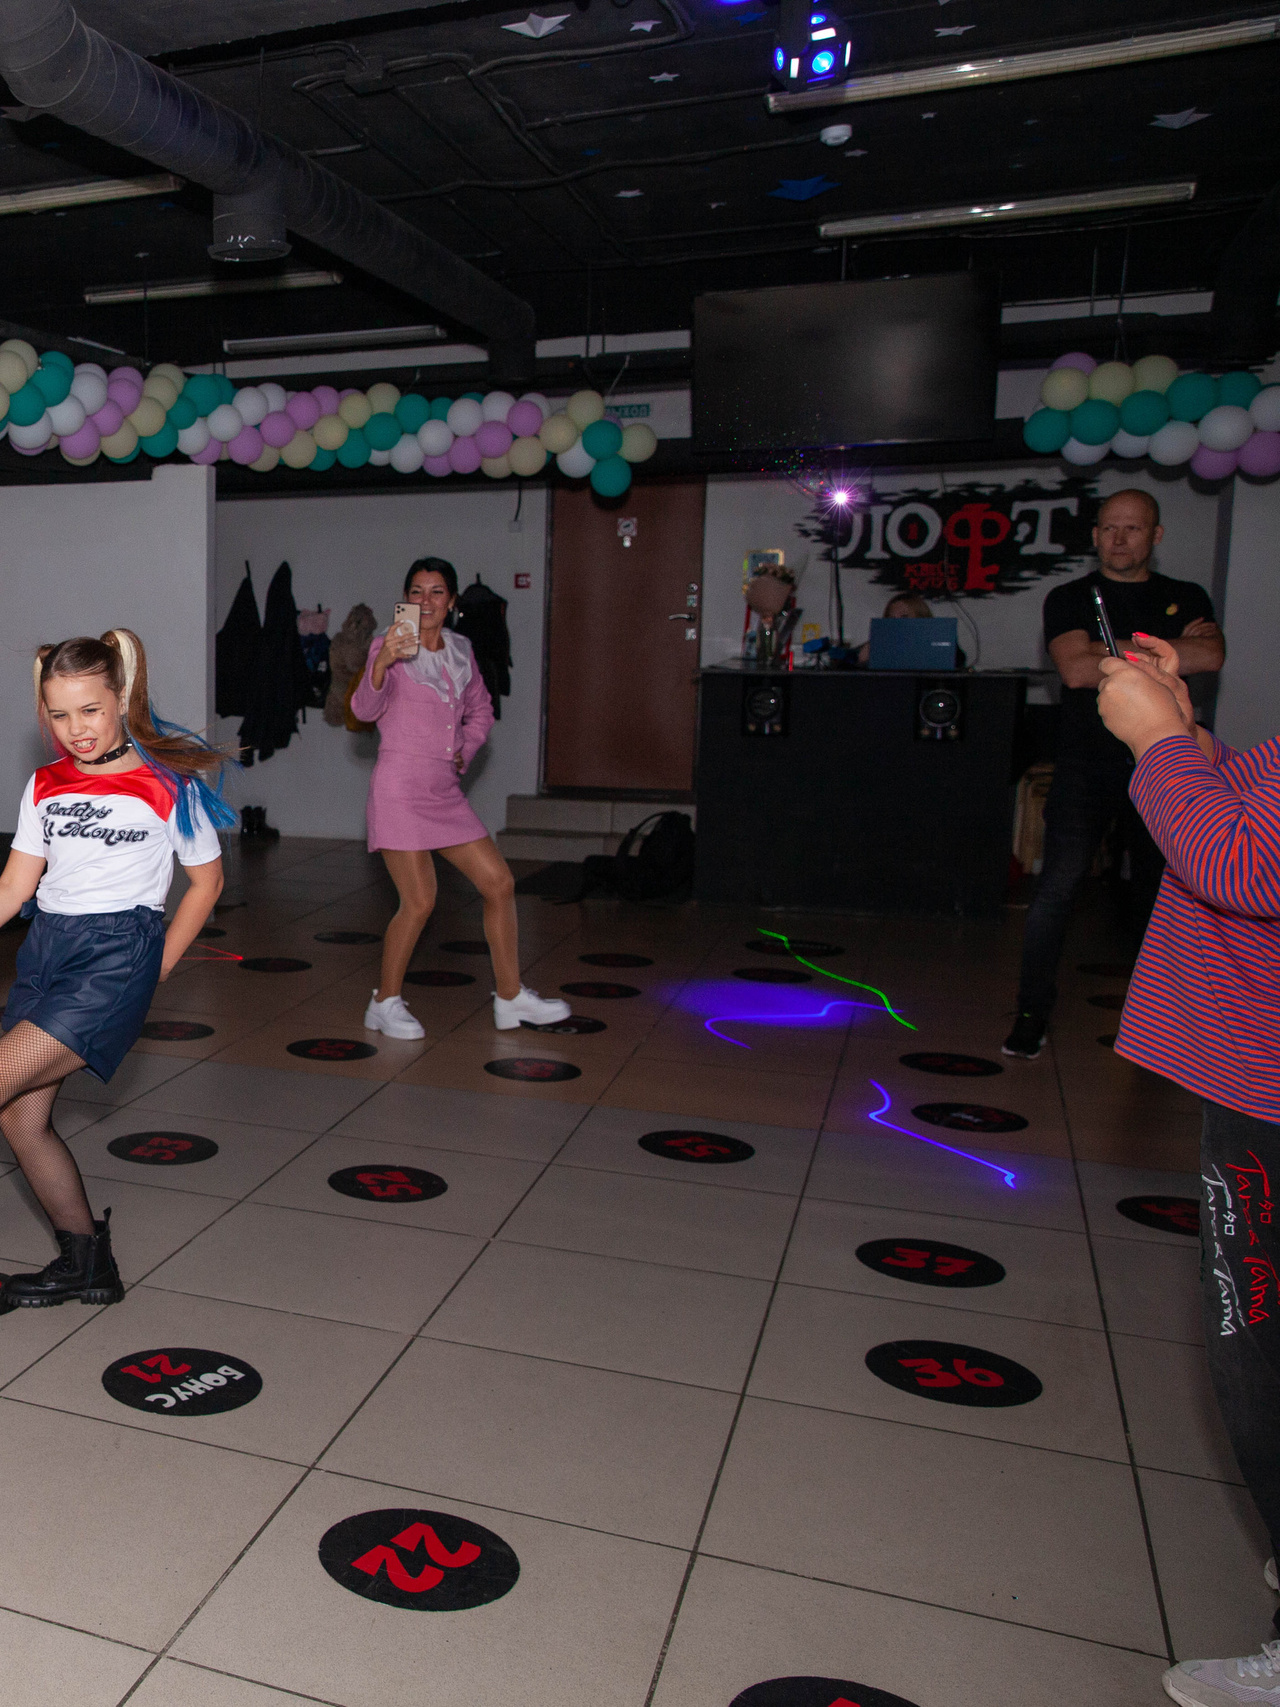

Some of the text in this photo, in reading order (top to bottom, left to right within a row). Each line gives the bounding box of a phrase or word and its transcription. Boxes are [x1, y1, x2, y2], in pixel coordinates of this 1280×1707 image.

[57, 822, 149, 846] Monster
[130, 1137, 193, 1161] 53
[664, 1136, 732, 1158] 51
[355, 1171, 423, 1198] 52
[881, 1247, 977, 1277] 37
[120, 1353, 192, 1384] 21
[897, 1357, 1005, 1388] 36
[144, 1364, 246, 1409] БОНУС
[350, 1521, 482, 1593] 22
